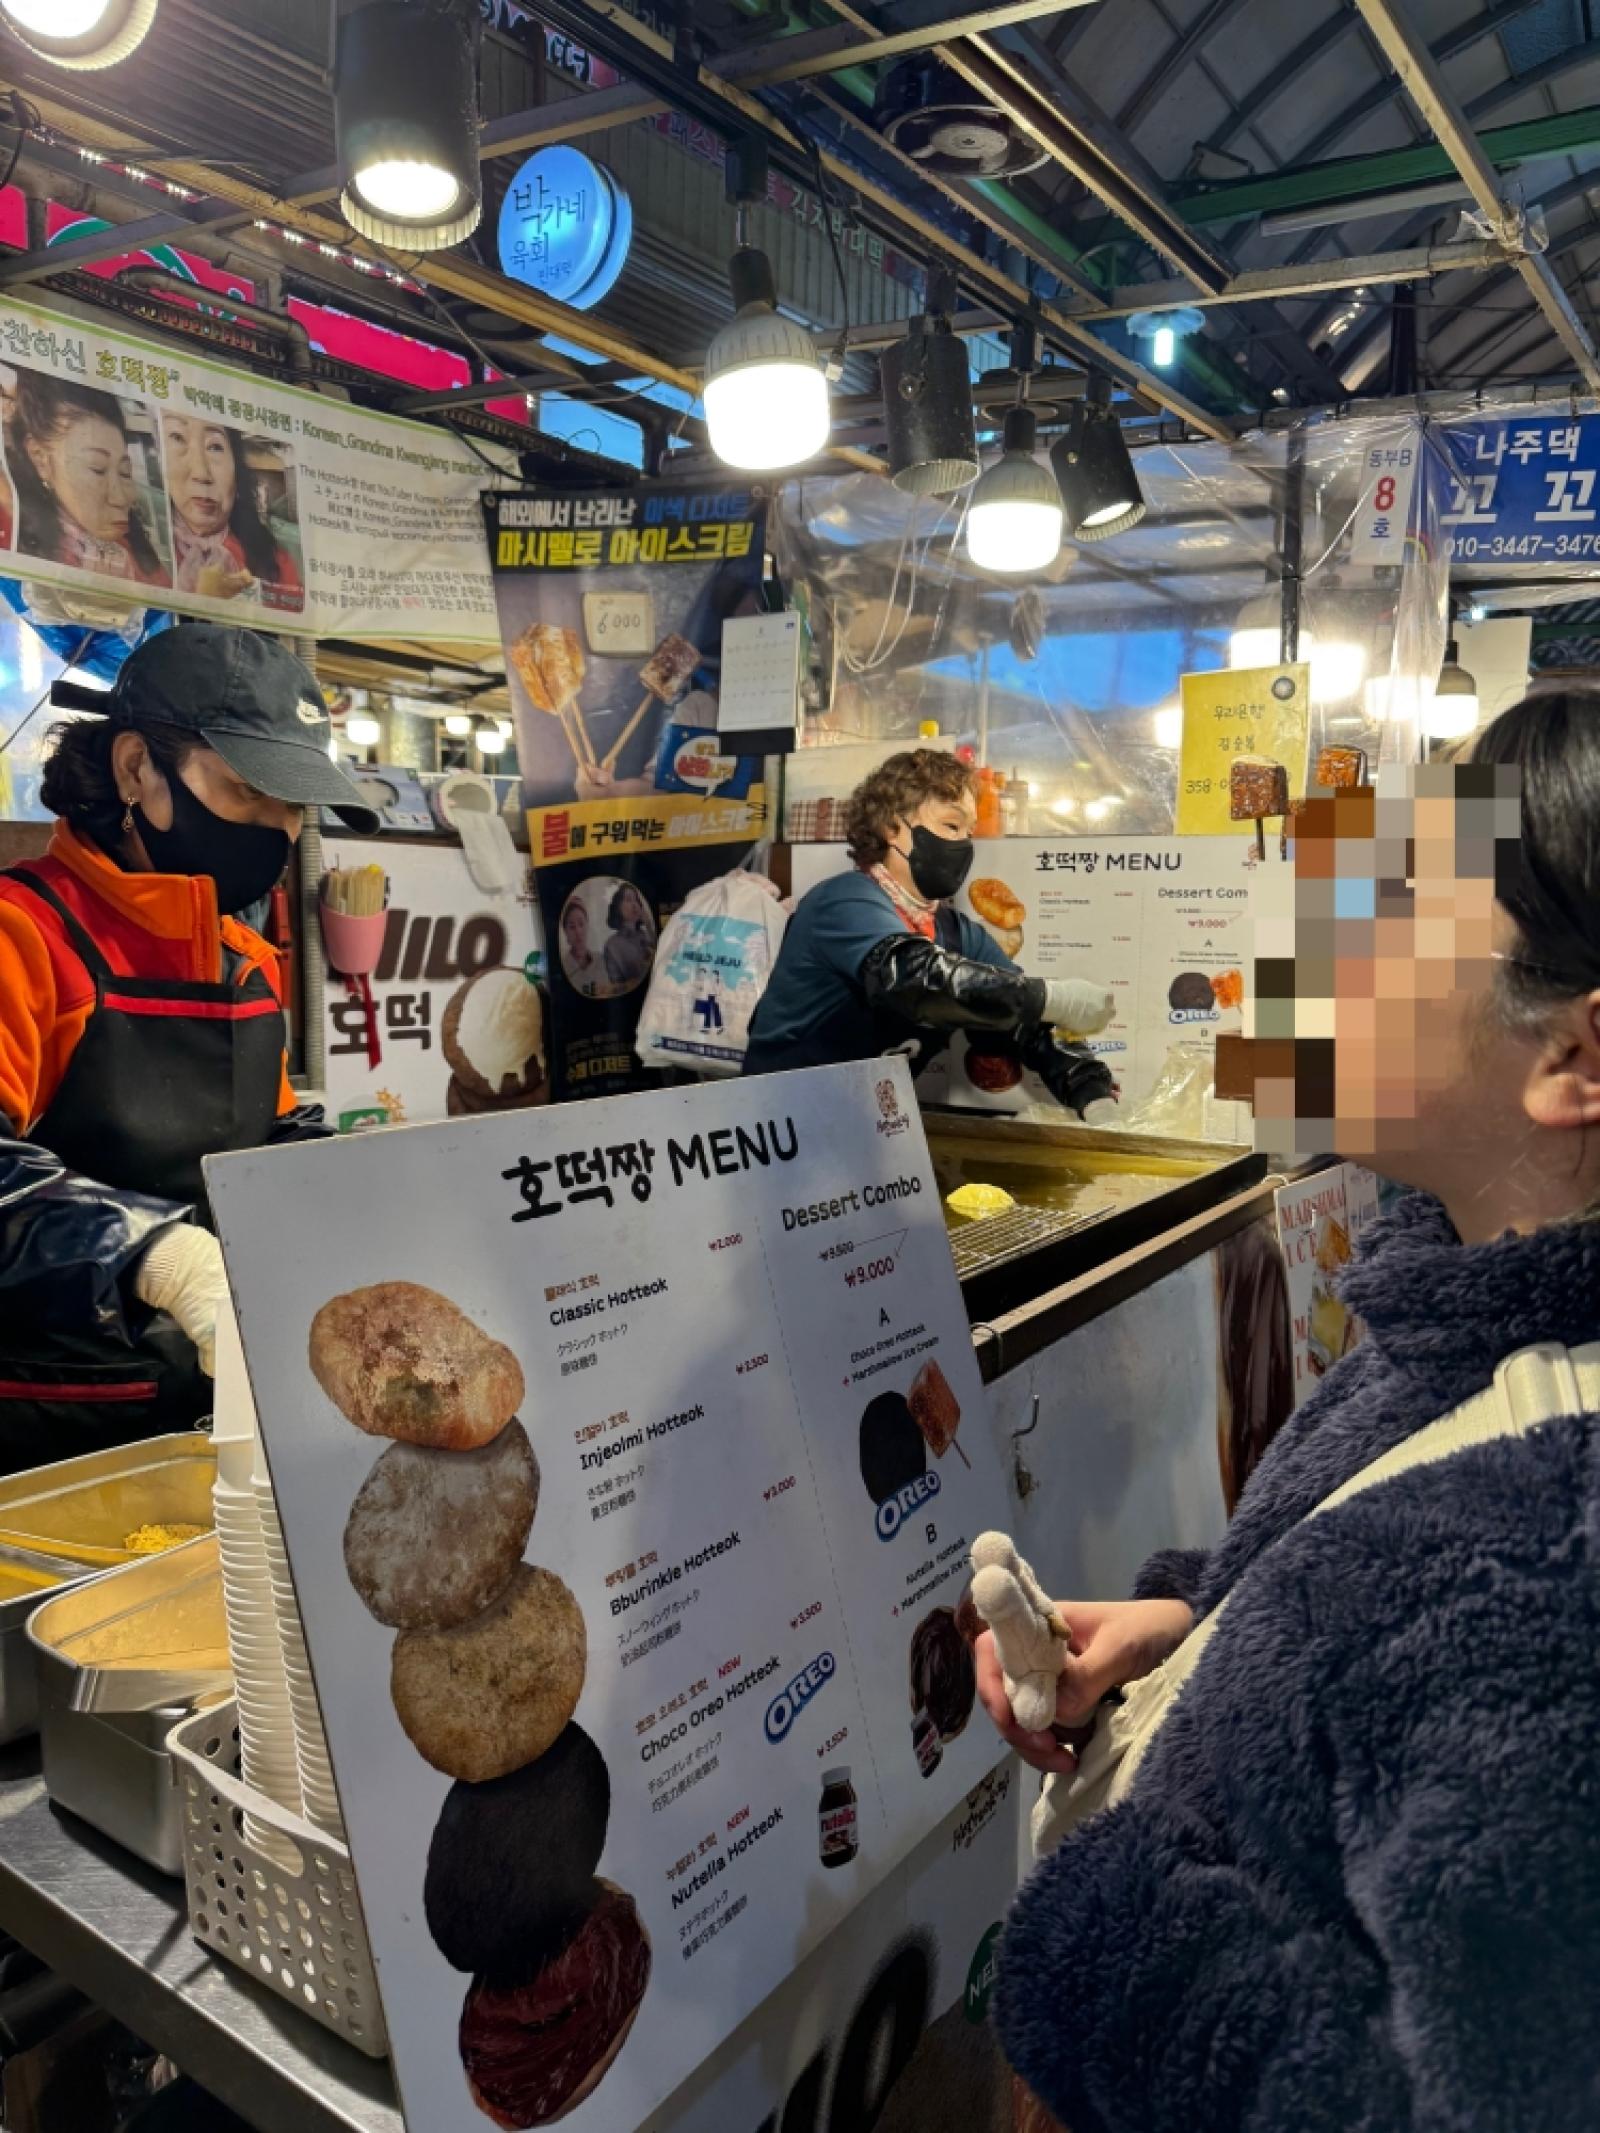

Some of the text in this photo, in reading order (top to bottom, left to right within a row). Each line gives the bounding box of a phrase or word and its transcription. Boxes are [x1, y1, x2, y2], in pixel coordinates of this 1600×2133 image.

[0, 318, 88, 374] 찬하신
[1475, 426, 1582, 466] 나주댁
[1374, 476, 1396, 511] 8
[497, 522, 754, 566] 마시멜로 아이스크림
[1370, 518, 1390, 538] 호
[1106, 852, 1183, 872] MENU
[1158, 887, 1249, 899] Dessert Com
[501, 1116, 799, 1223] 호떡짱 MENU
[781, 1175, 921, 1231] Dessert Combo
[549, 1277, 669, 1327] Classic Hotteok
[879, 1307, 890, 1327] A
[579, 1403, 705, 1470] Injeolmi Hotteok
[877, 1471, 939, 1537] OREO
[926, 1523, 937, 1544] B
[610, 1530, 741, 1616] Bburinkle Hotteok
[717, 1654, 741, 1679] NEW
[641, 1653, 782, 1763] Choco Oreo Hotteok
[766, 1652, 835, 1742] OREO
[726, 1803, 750, 1832] NEW
[671, 1806, 784, 1910] Nutella Hotteok
